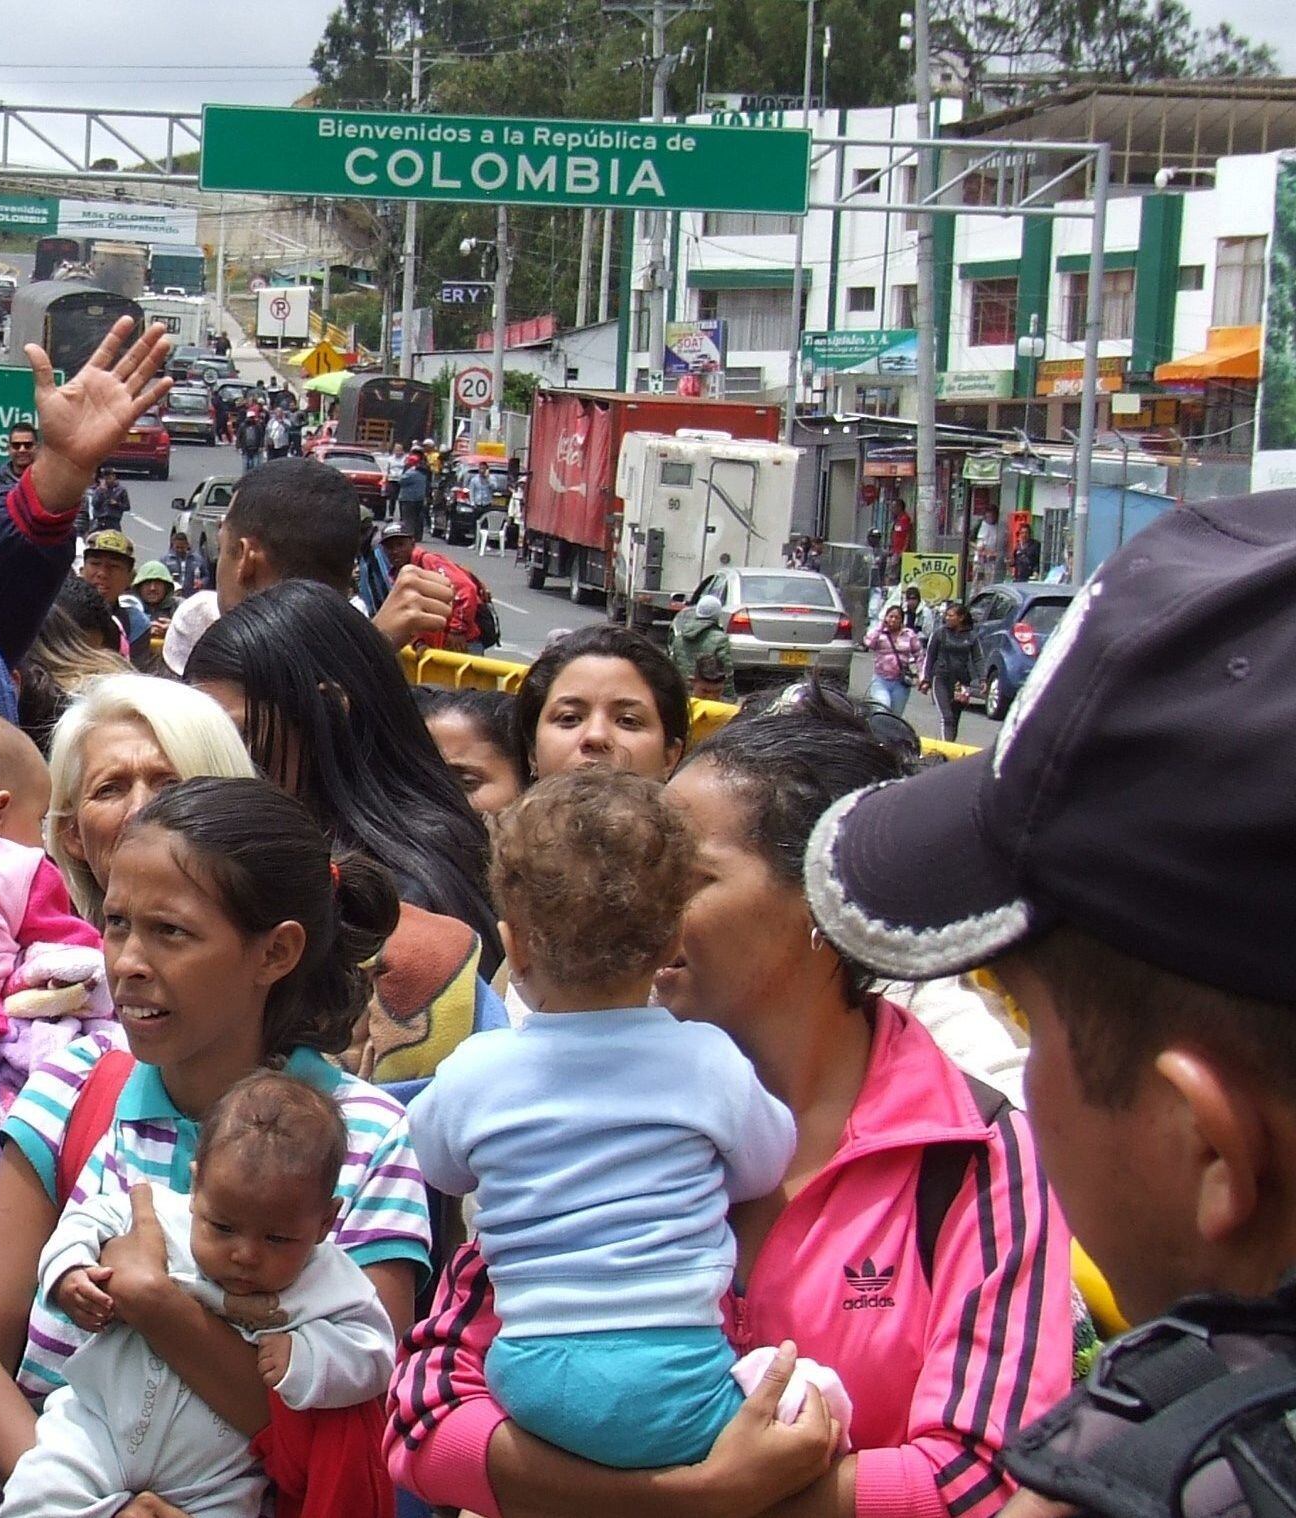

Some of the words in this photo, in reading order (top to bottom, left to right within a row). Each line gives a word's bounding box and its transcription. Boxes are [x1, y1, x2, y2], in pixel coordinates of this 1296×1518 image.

[319, 119, 471, 143] Bienvenidos
[480, 130, 494, 144] a
[504, 126, 524, 145] la
[534, 127, 656, 151] República
[666, 132, 696, 152] de
[345, 147, 666, 196] COLOMBIA
[463, 379, 487, 397] 20
[668, 498, 680, 510] 90
[903, 561, 956, 584] CAMBIO
[843, 1294, 895, 1310] adidas
